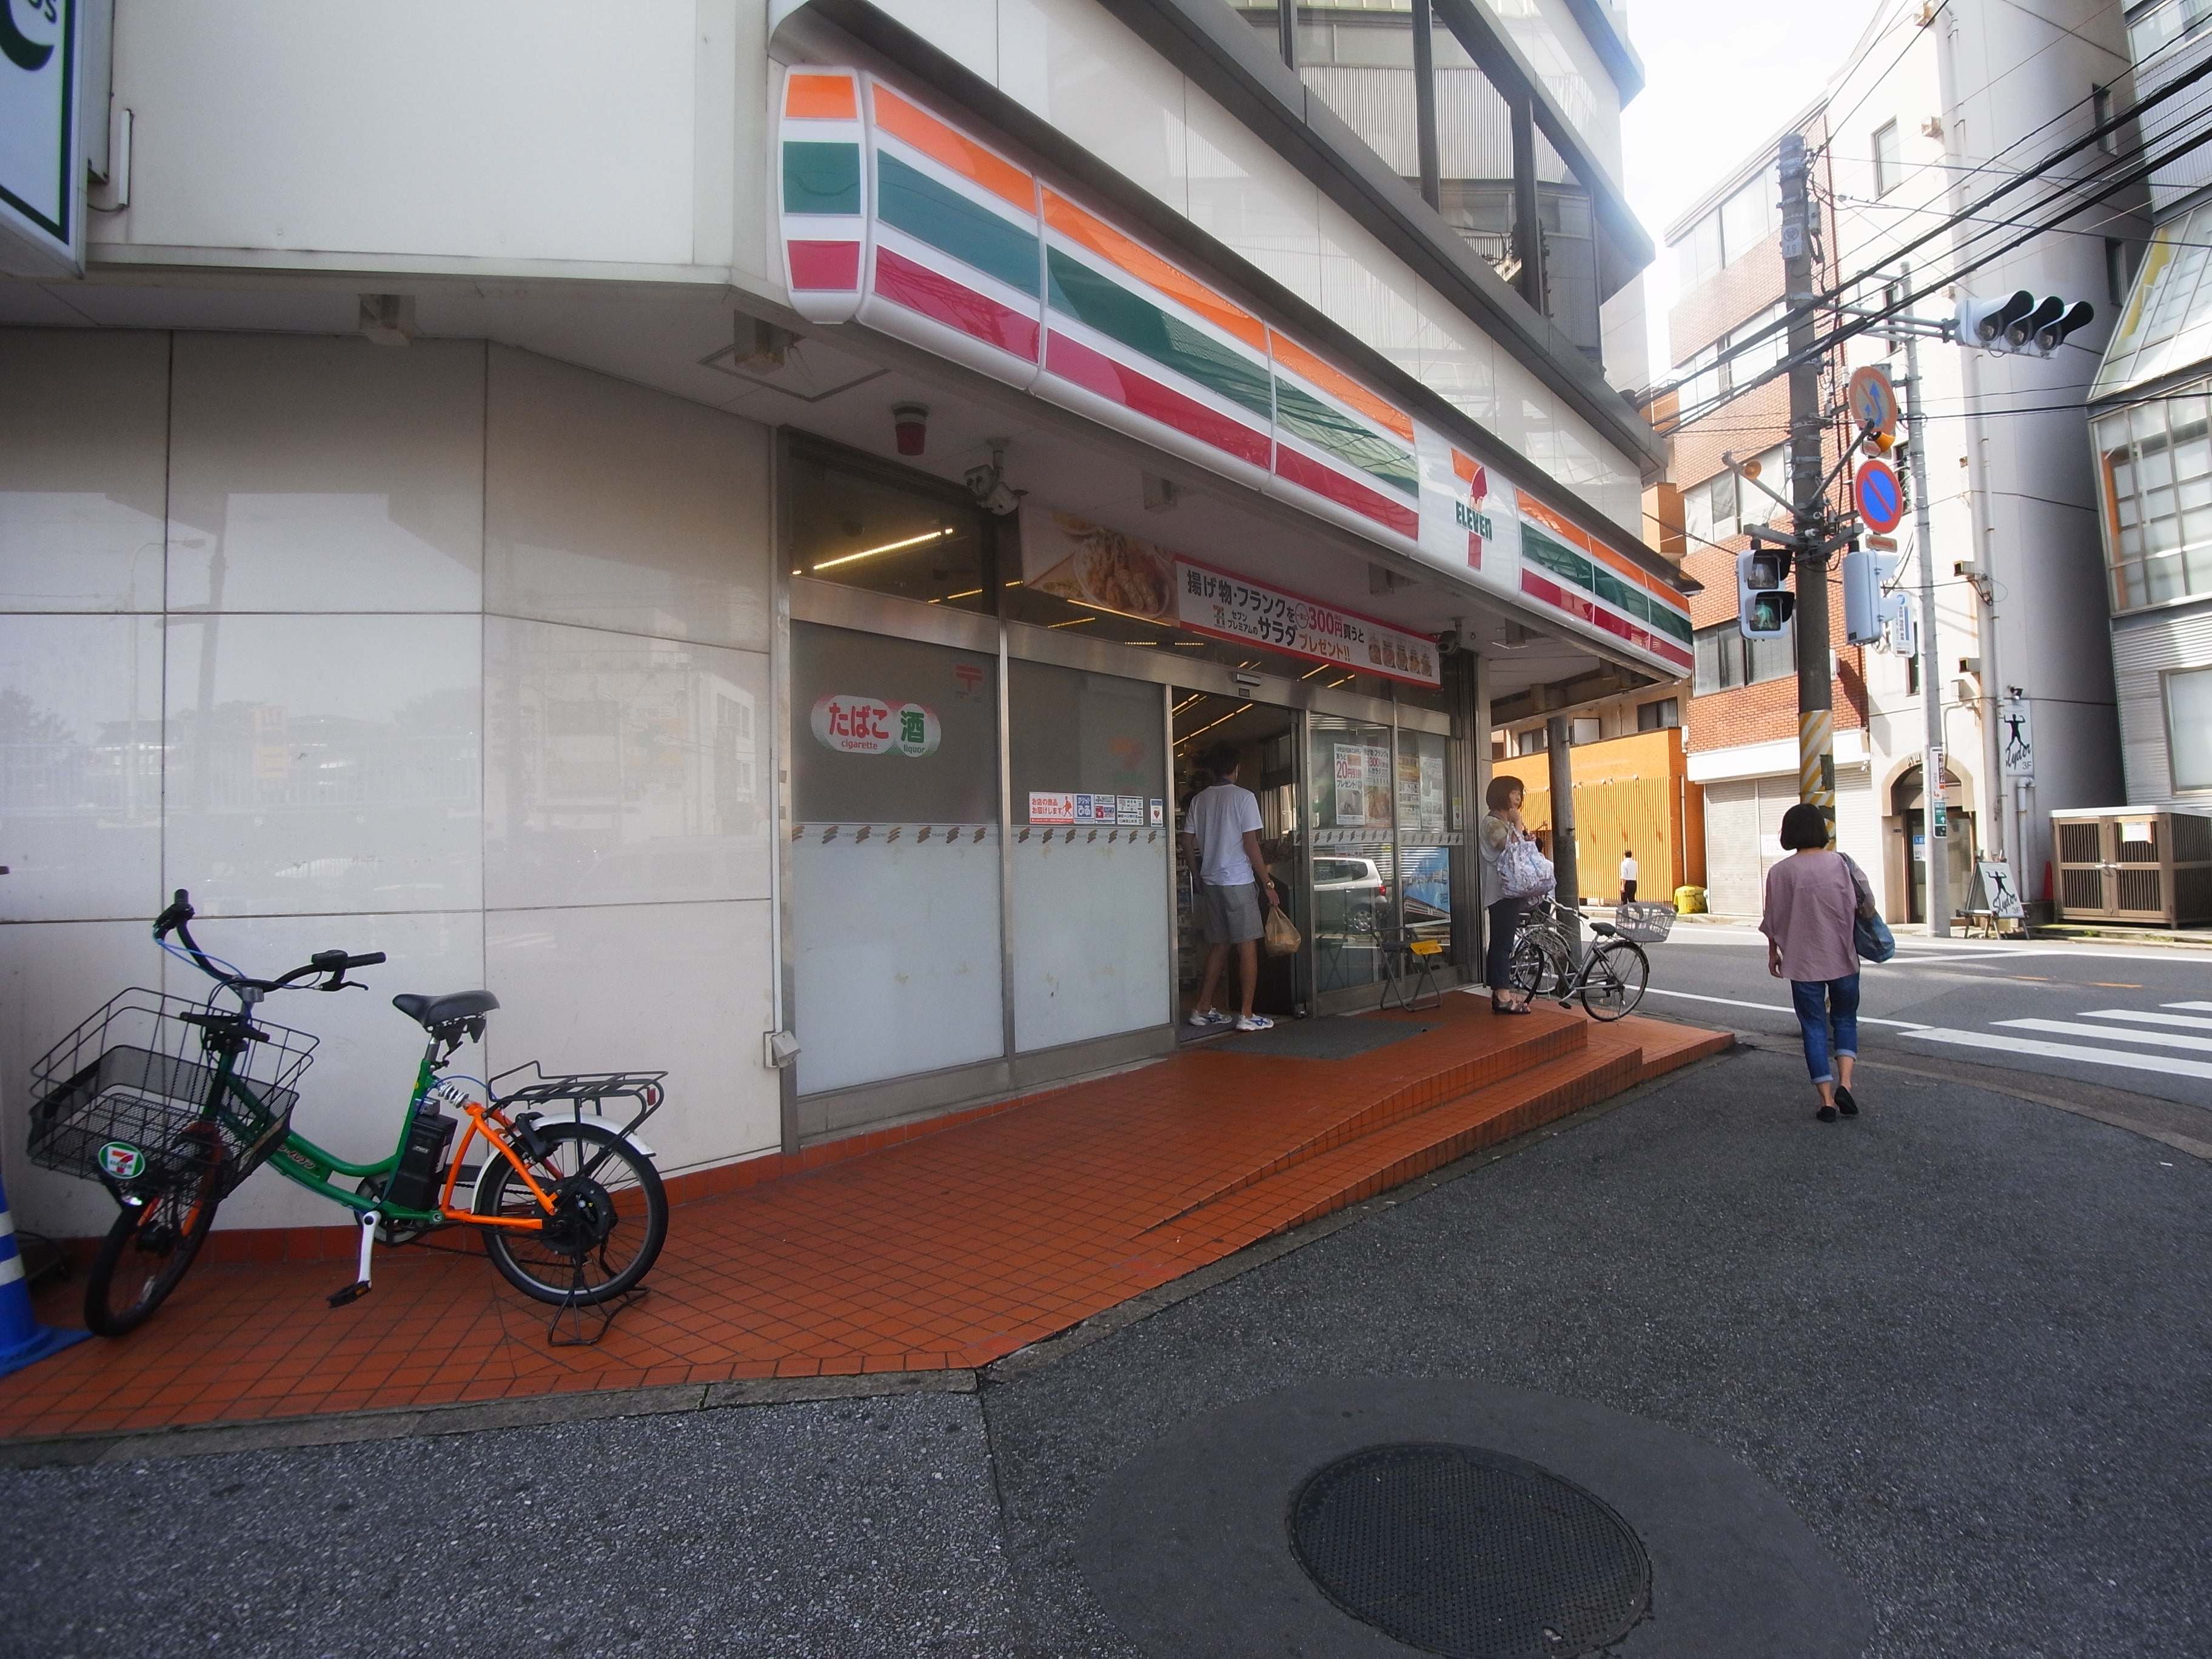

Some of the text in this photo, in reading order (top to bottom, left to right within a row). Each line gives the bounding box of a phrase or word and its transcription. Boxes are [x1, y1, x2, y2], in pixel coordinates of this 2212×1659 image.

[1232, 610, 1247, 622] セブン
[1227, 619, 1258, 635] プレミアムの
[1258, 616, 1298, 646] サラダ
[829, 702, 925, 743] たばこ 酒
[841, 739, 925, 754] cigarette liquor
[2022, 761, 2032, 770] 3F
